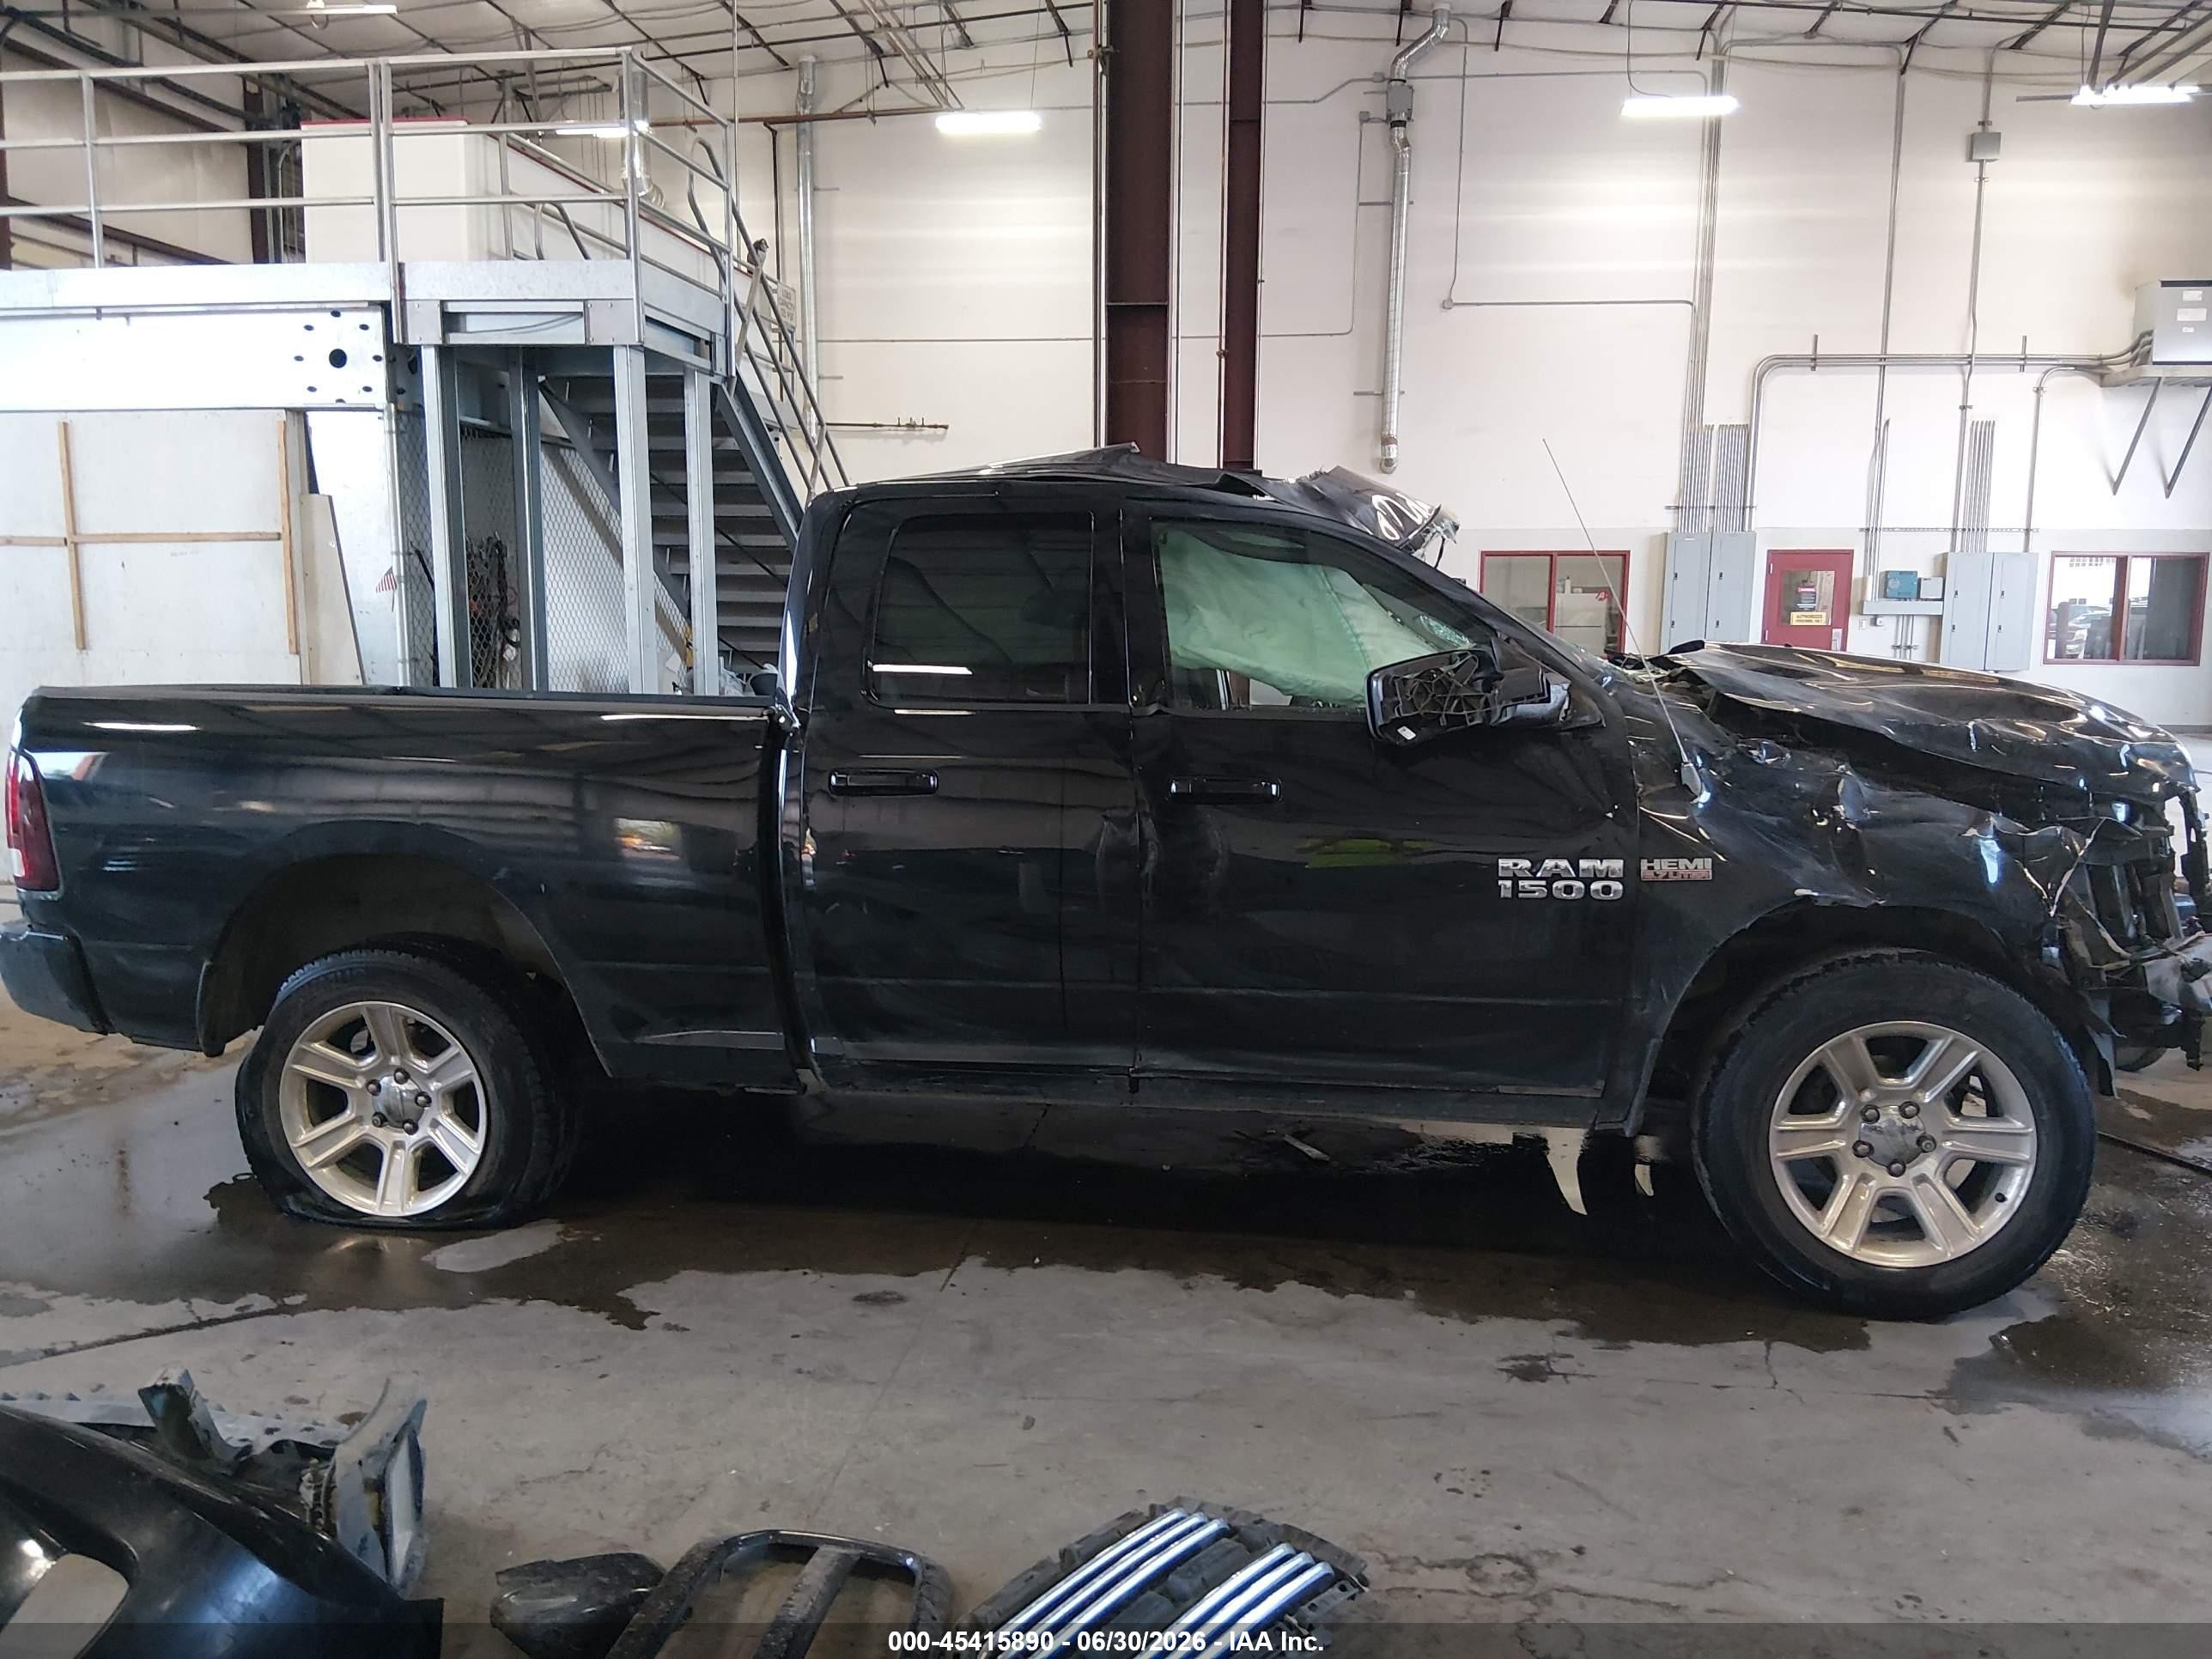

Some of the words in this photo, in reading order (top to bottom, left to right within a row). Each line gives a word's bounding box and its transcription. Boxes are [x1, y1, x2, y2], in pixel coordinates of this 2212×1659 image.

[1498, 858, 1624, 878] RAM
[1641, 858, 1712, 870] HEMI
[1498, 879, 1624, 900] 1500
